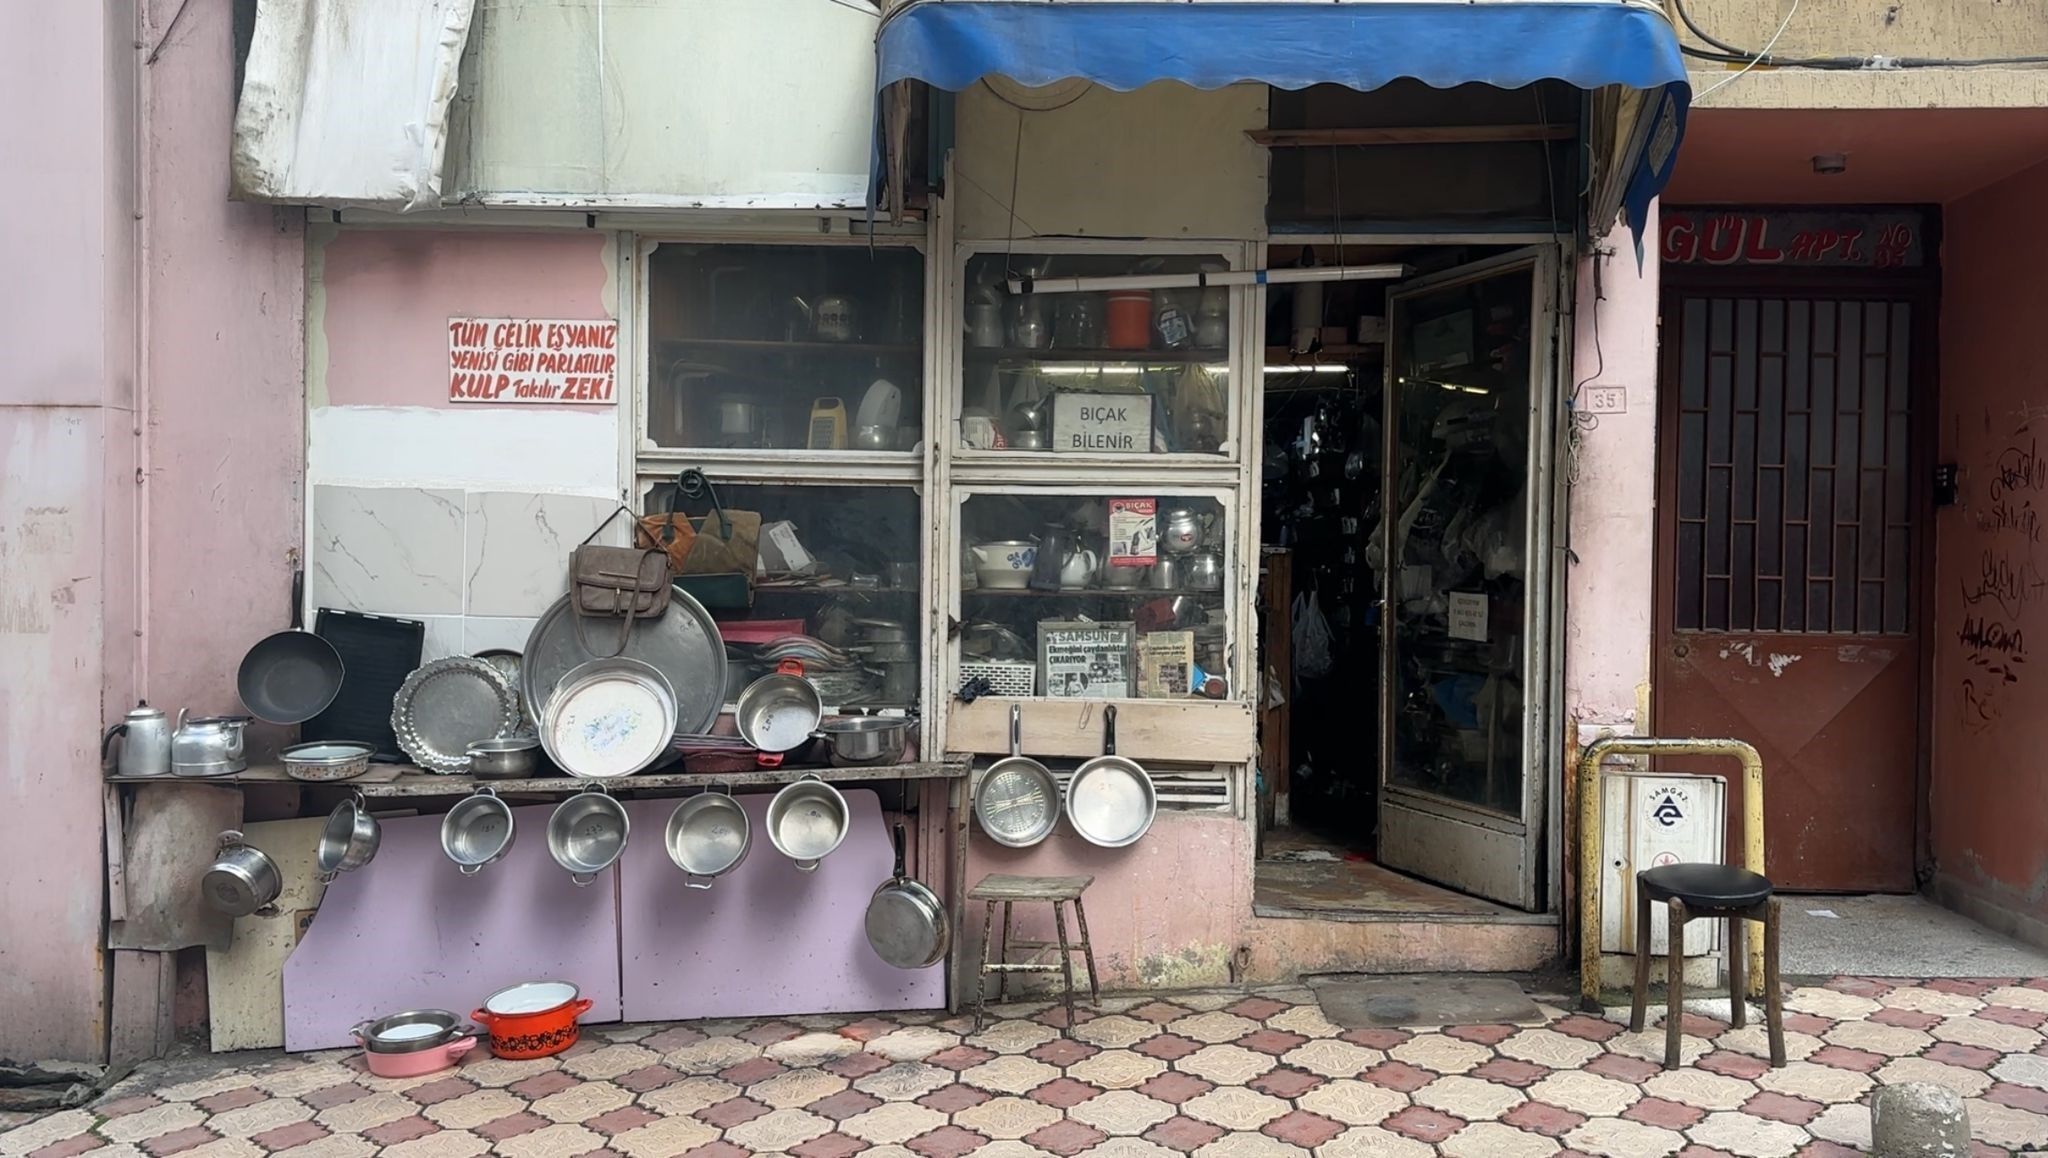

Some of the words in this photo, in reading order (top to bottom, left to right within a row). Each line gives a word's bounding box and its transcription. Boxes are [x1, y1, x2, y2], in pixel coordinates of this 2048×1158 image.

[1661, 215, 1785, 265] GÜL
[450, 319, 489, 348] TÜM
[493, 319, 544, 351] ÇELİK
[547, 324, 617, 351] EŞYANIZ
[451, 347, 499, 371] YENİSİ
[502, 348, 535, 373] GİBİ
[536, 353, 616, 374] PARLATILIR
[450, 373, 510, 399] KULP
[513, 378, 561, 399] Takılır
[560, 375, 614, 400] ZEKİ
[1595, 393, 1616, 409] 35
[1080, 406, 1127, 424] BIÇAK
[1072, 433, 1133, 449] BİLENİR
[1649, 787, 1688, 801] SAMGAZ
